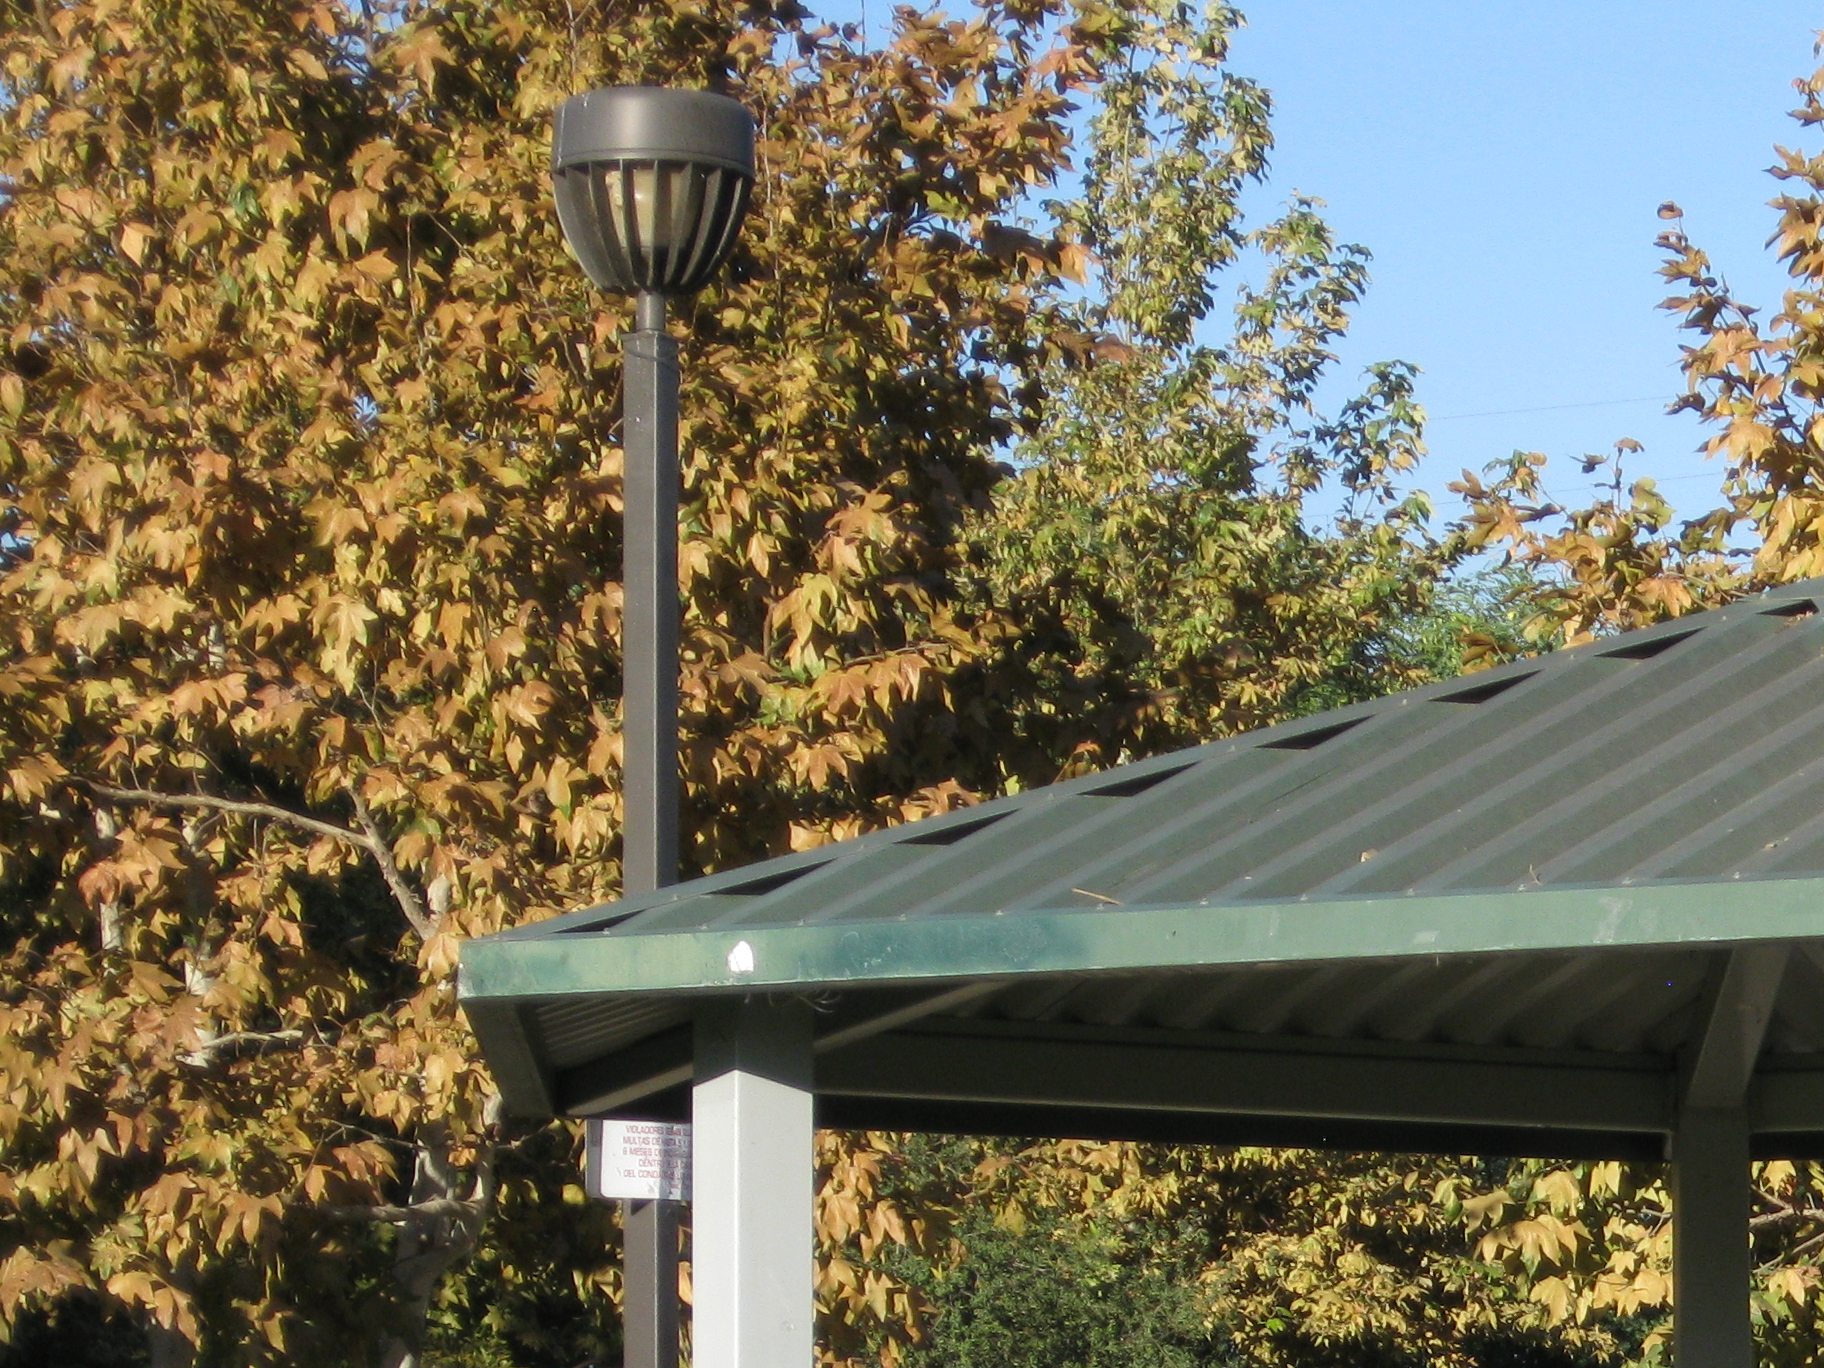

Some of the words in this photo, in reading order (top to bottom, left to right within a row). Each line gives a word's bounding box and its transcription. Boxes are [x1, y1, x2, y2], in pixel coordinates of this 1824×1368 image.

[622, 1136, 650, 1146] MULTAS
[629, 1147, 652, 1157] MESES
[623, 1169, 636, 1178] DEL
